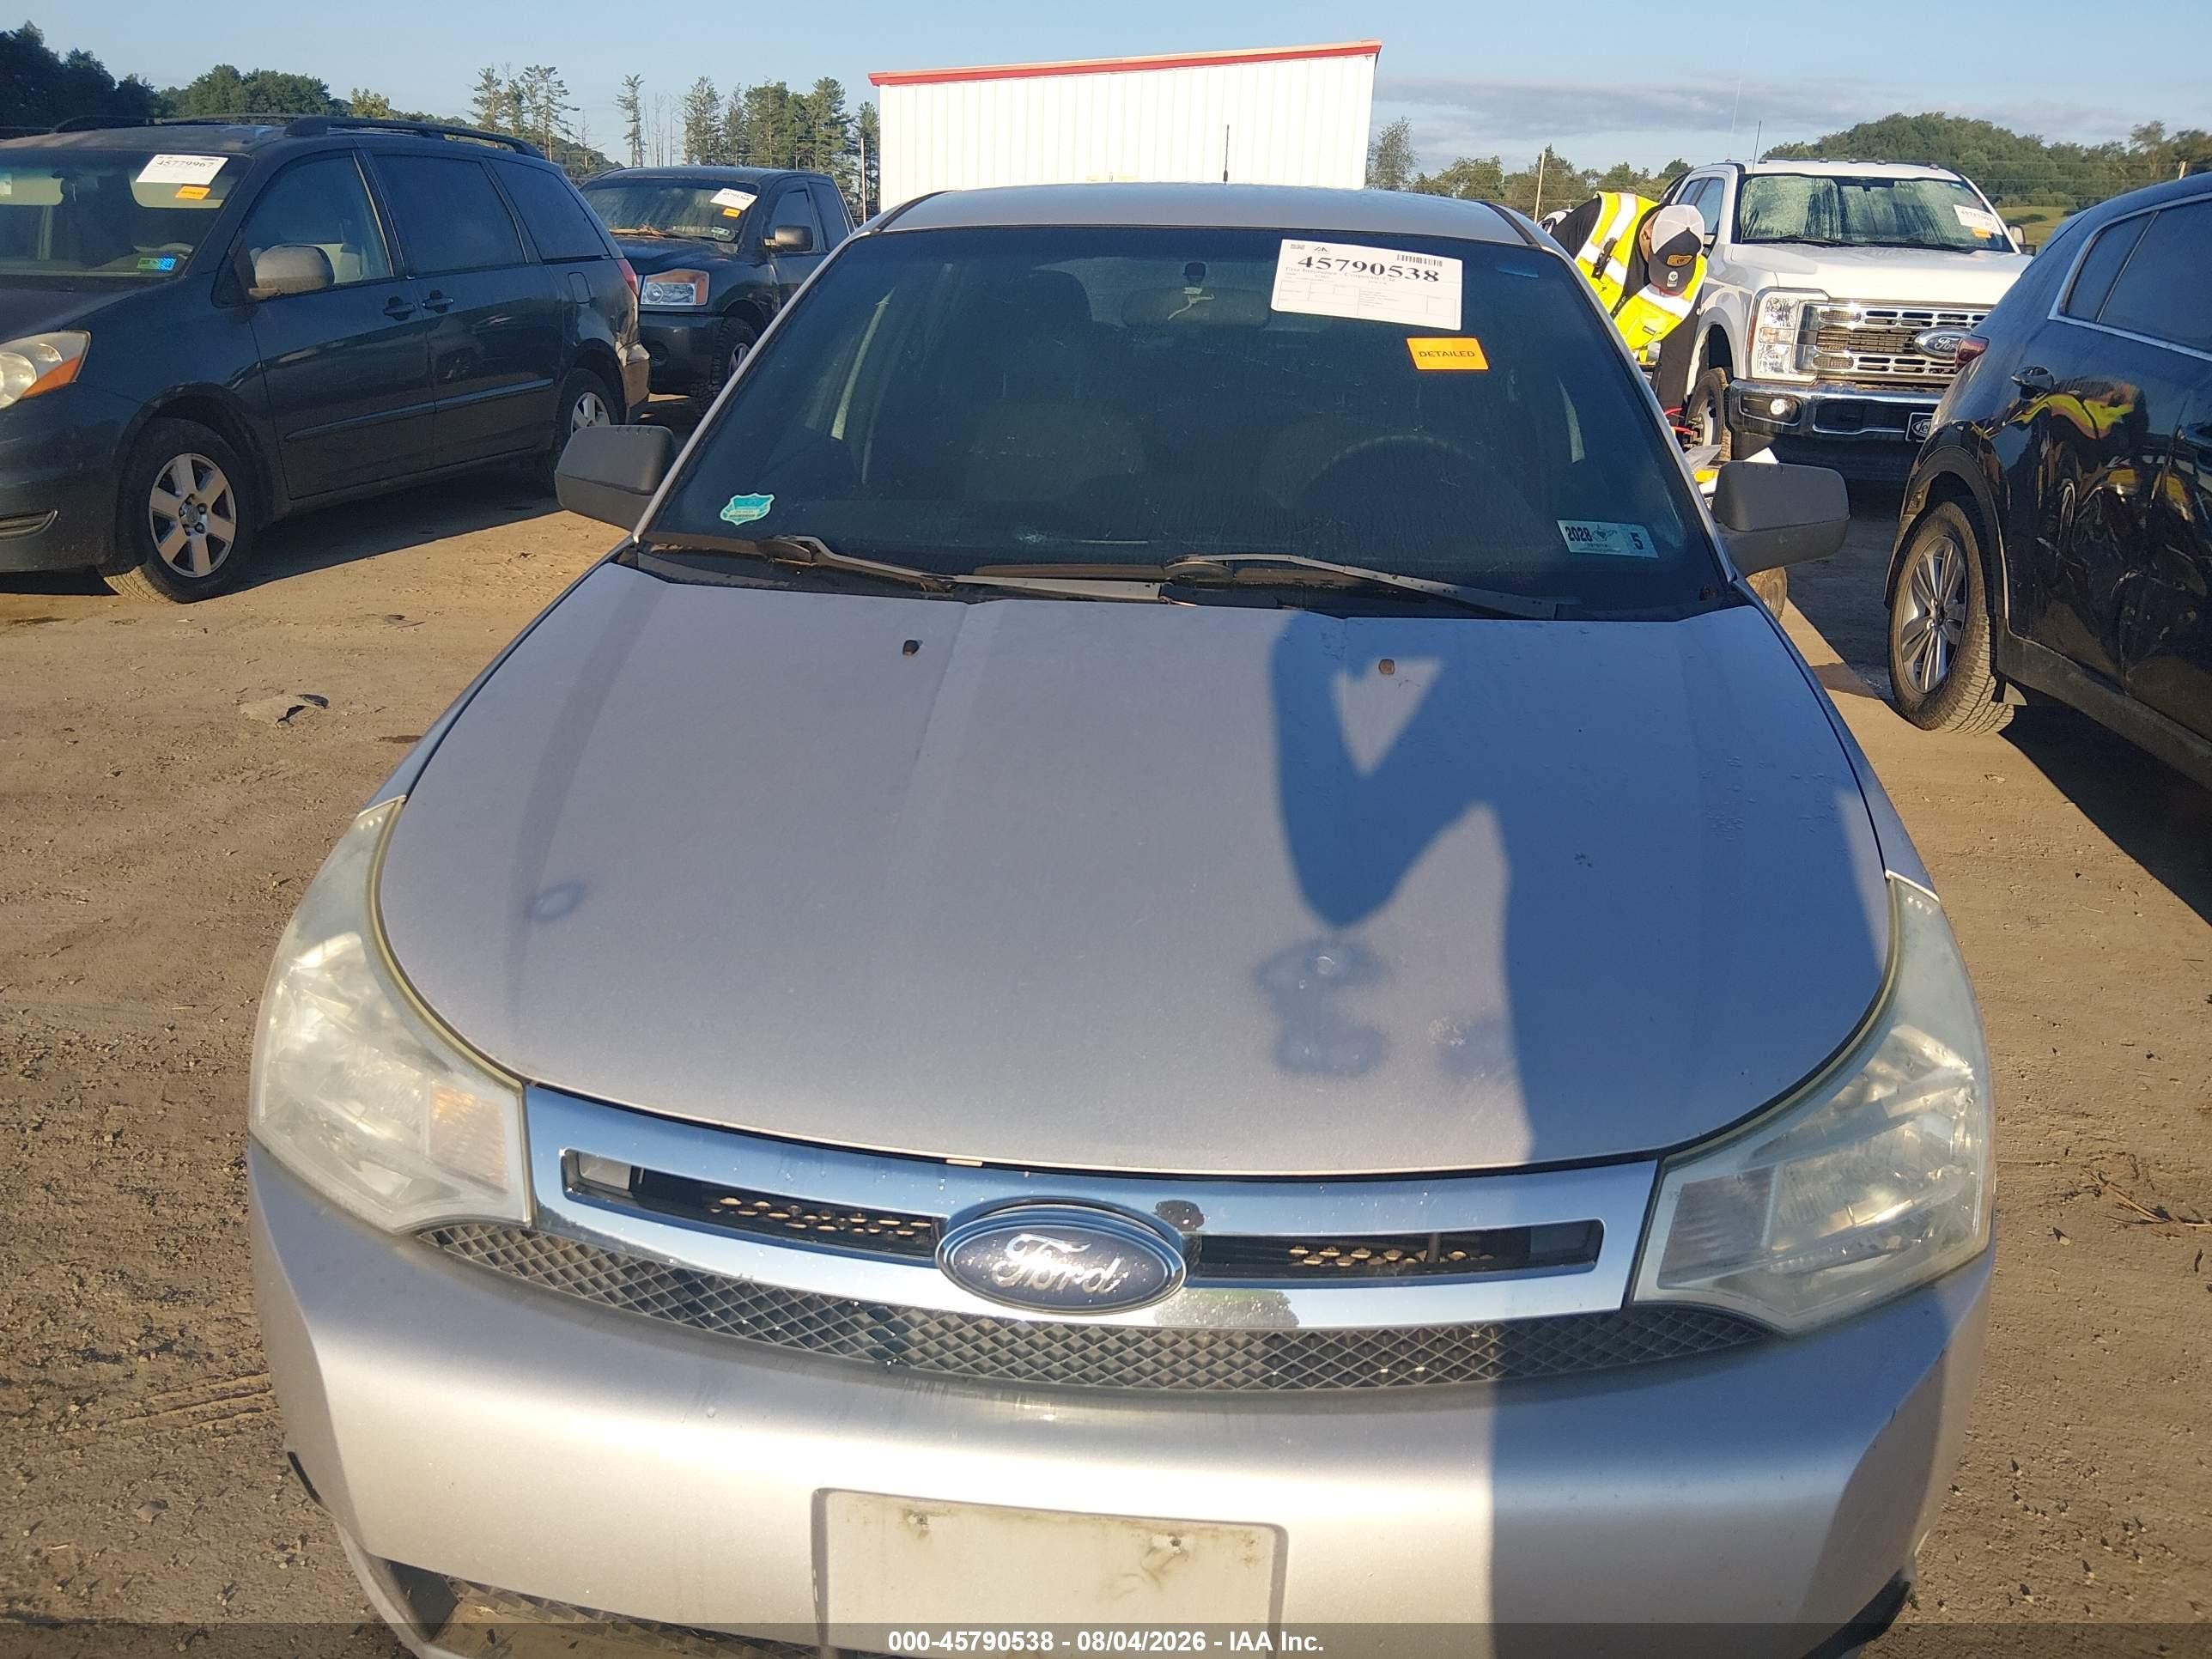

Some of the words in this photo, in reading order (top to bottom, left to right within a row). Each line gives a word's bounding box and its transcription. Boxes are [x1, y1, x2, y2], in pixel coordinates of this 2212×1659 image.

[1297, 256, 1439, 283] 45790538
[1934, 337, 1960, 350] For
[1419, 349, 1475, 358] DETAILED
[1565, 526, 1593, 542] 2028
[1630, 532, 1644, 550] 5
[991, 1233, 1127, 1294] Ford
